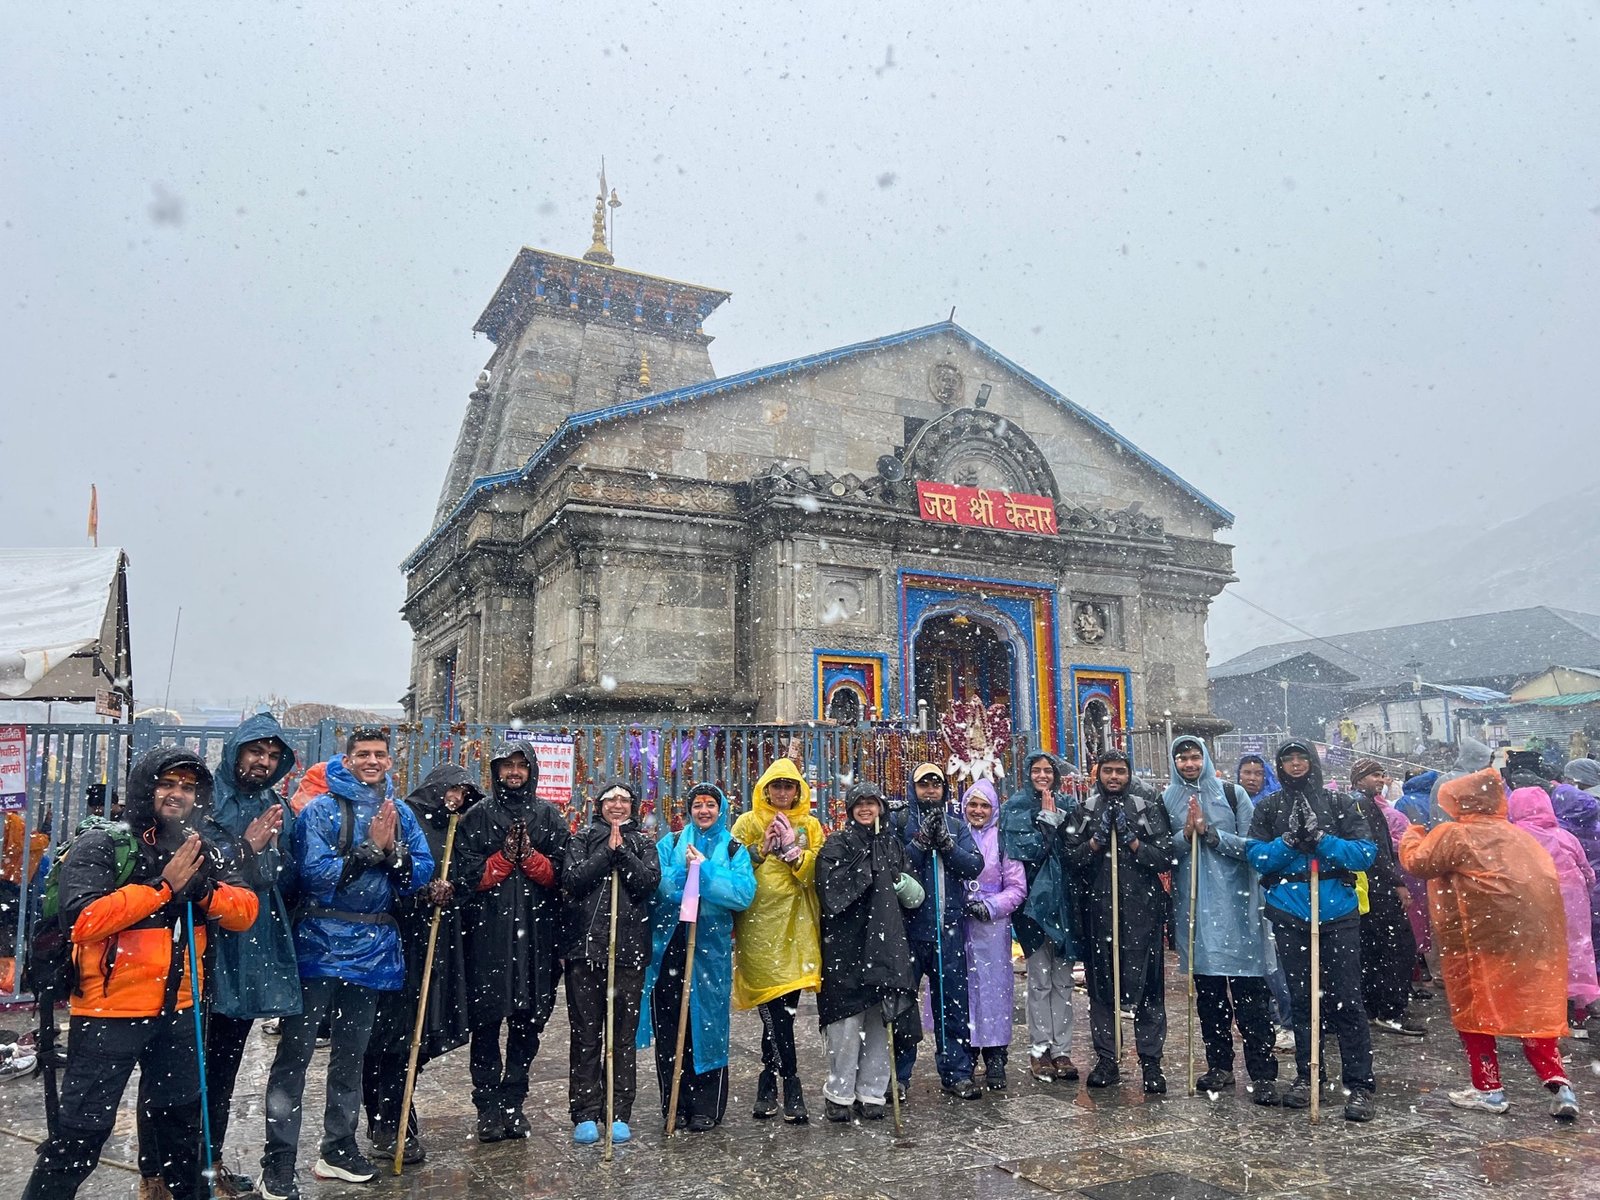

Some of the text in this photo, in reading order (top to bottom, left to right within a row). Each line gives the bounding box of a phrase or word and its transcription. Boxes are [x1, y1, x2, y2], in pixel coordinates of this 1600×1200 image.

[923, 488, 1055, 534] जय श्री केदार
